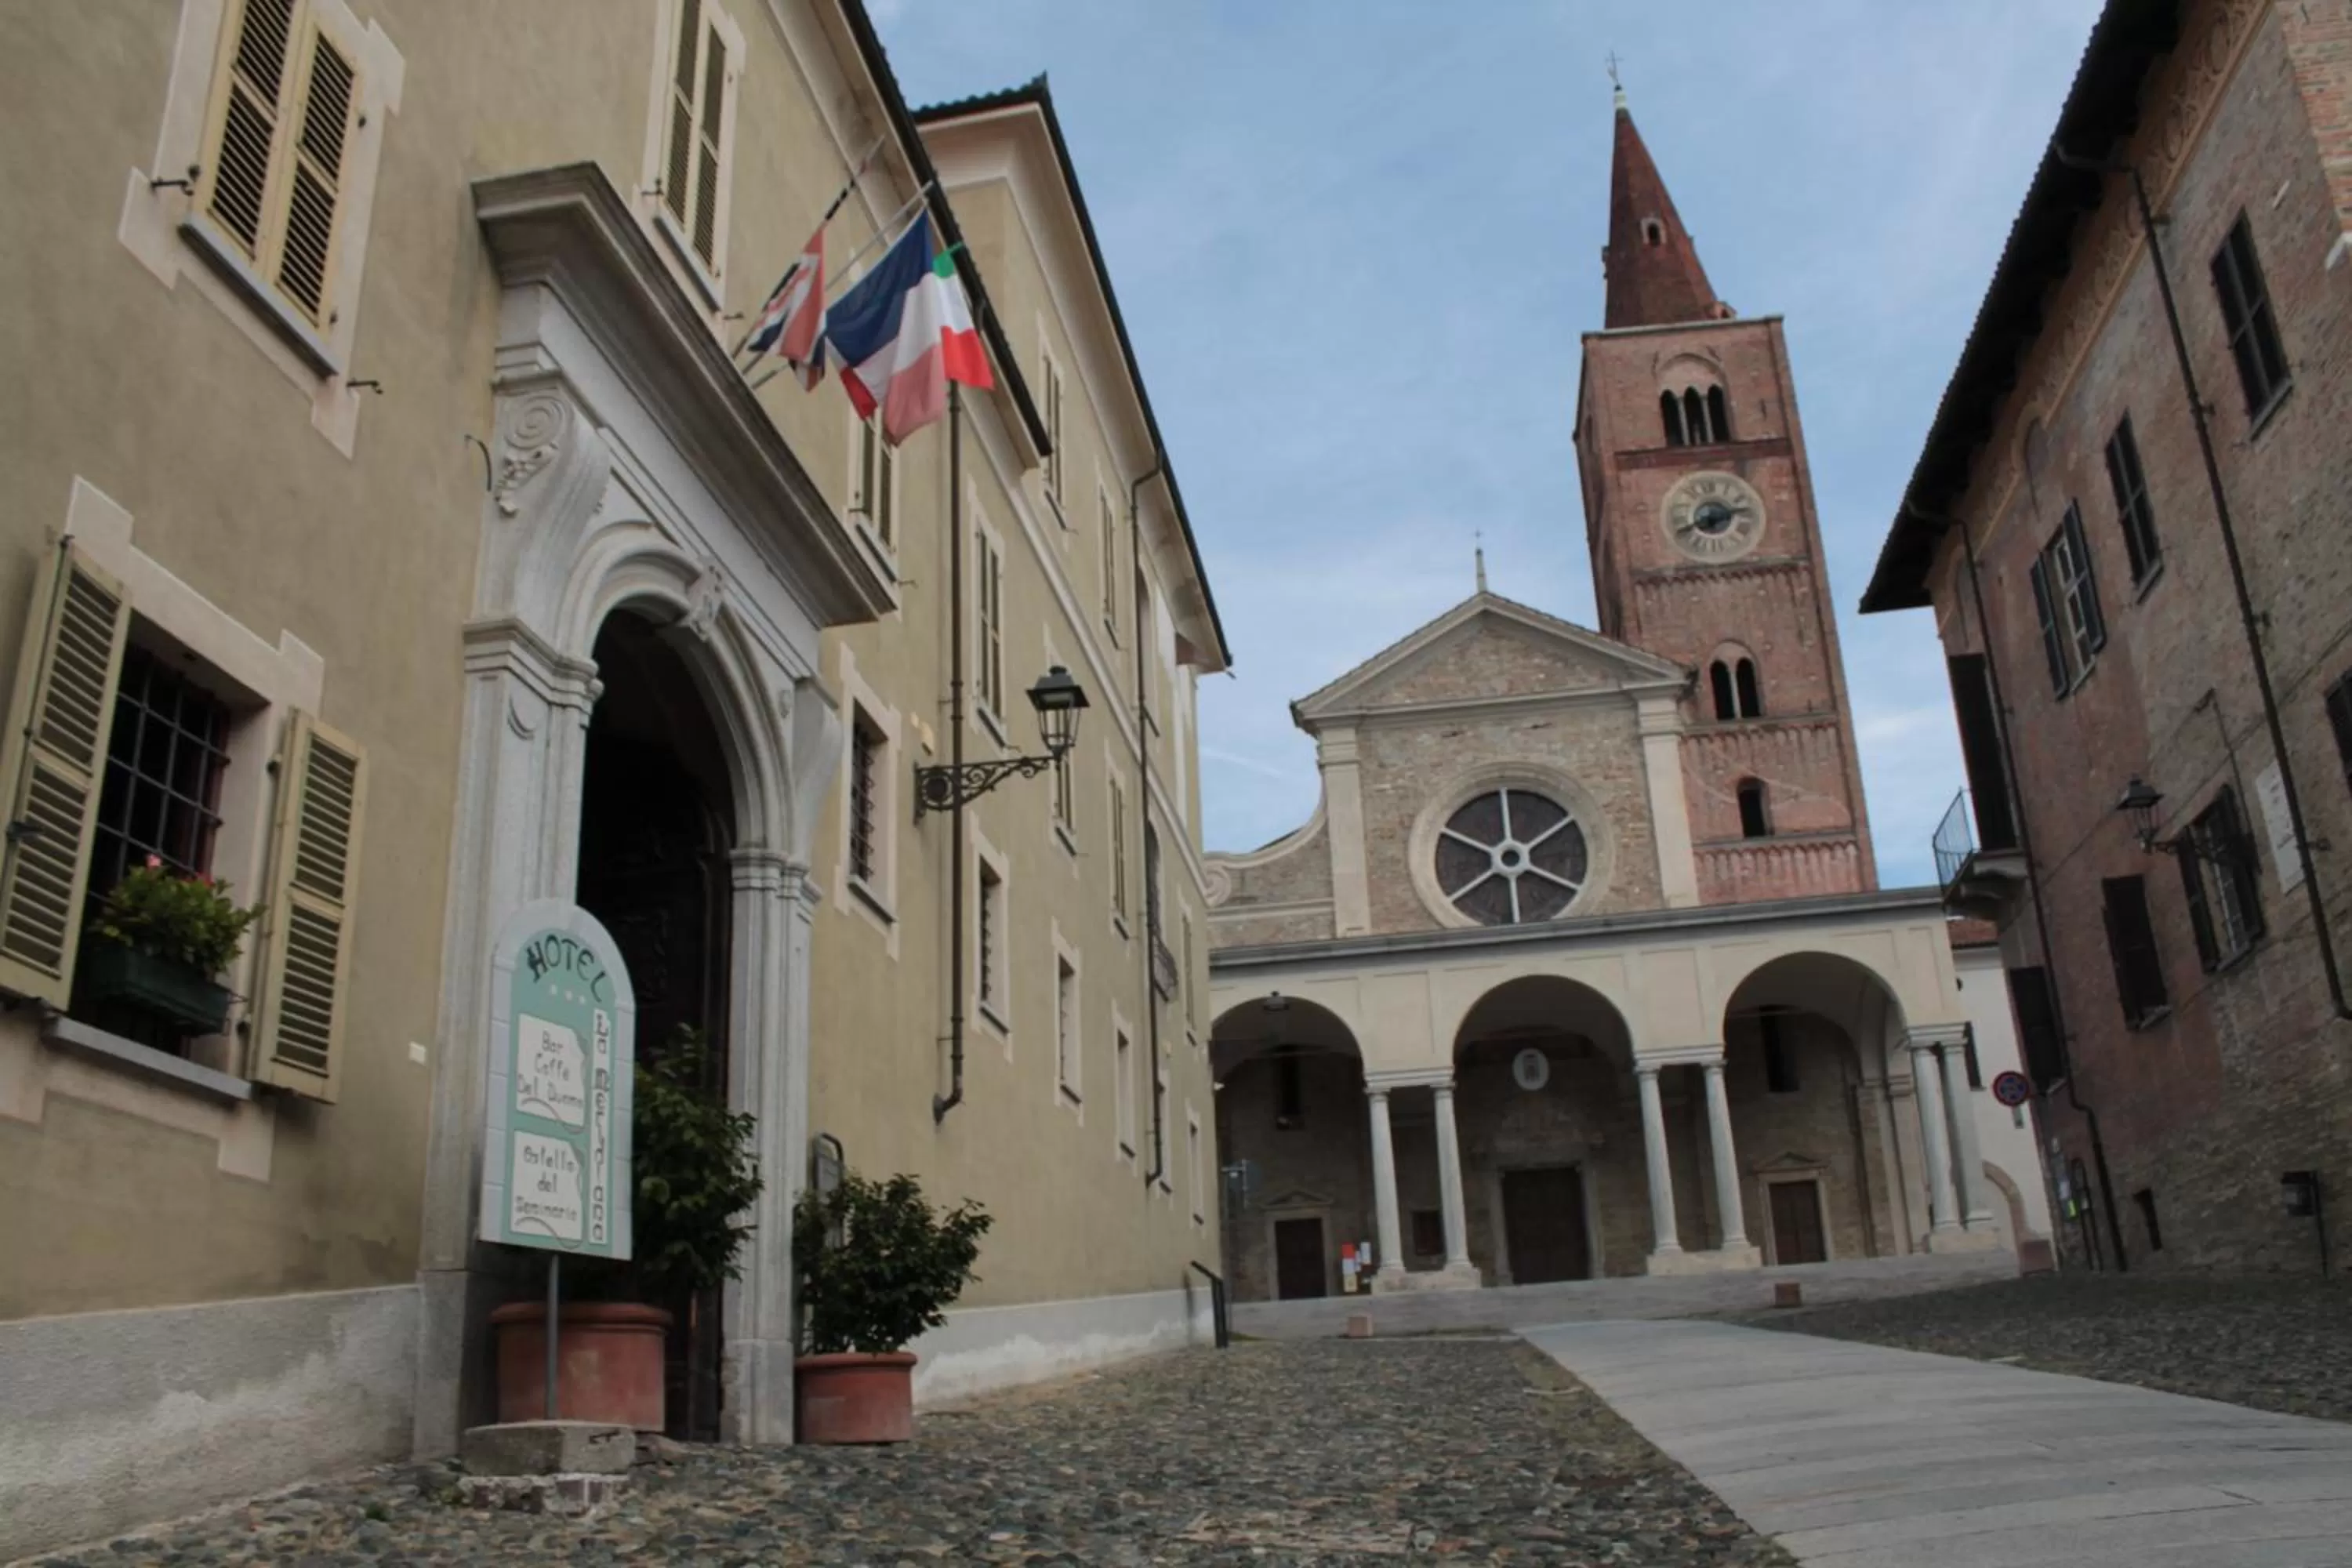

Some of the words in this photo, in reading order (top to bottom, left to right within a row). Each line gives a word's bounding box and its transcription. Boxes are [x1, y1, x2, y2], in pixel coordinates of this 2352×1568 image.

[527, 934, 606, 1003] HOTEL
[542, 1029, 564, 1053] Bar
[537, 1171, 557, 1192] del
